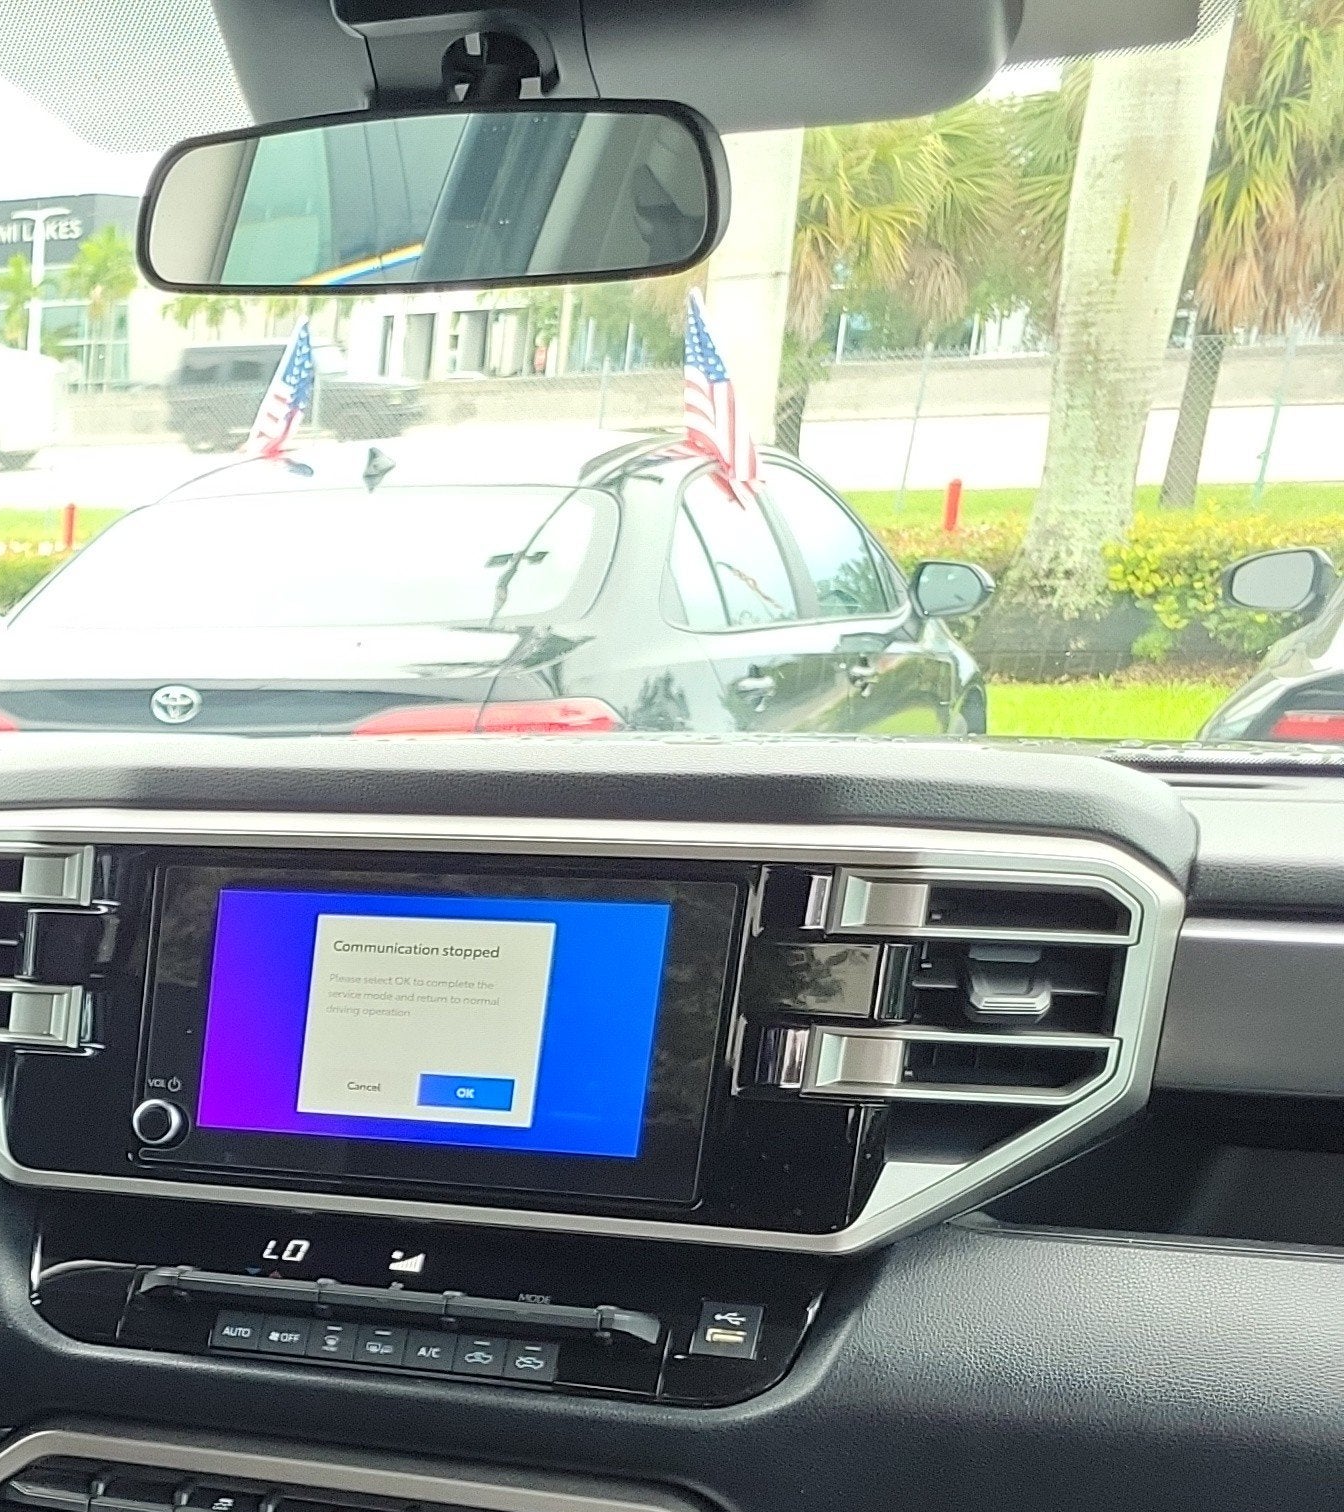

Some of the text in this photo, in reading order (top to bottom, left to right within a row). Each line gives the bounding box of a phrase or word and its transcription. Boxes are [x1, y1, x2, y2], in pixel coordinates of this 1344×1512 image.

[22, 219, 83, 243] LKES
[333, 940, 500, 960] Communication stopped
[329, 973, 494, 990] Please select OK to complete the
[147, 1079, 166, 1088] VOL
[347, 1081, 381, 1092] Cancel
[455, 1087, 476, 1099] OK
[262, 1239, 311, 1262] LO
[221, 1325, 252, 1338] AUTO
[279, 1331, 301, 1343] OFF
[417, 1346, 441, 1359] A/C
